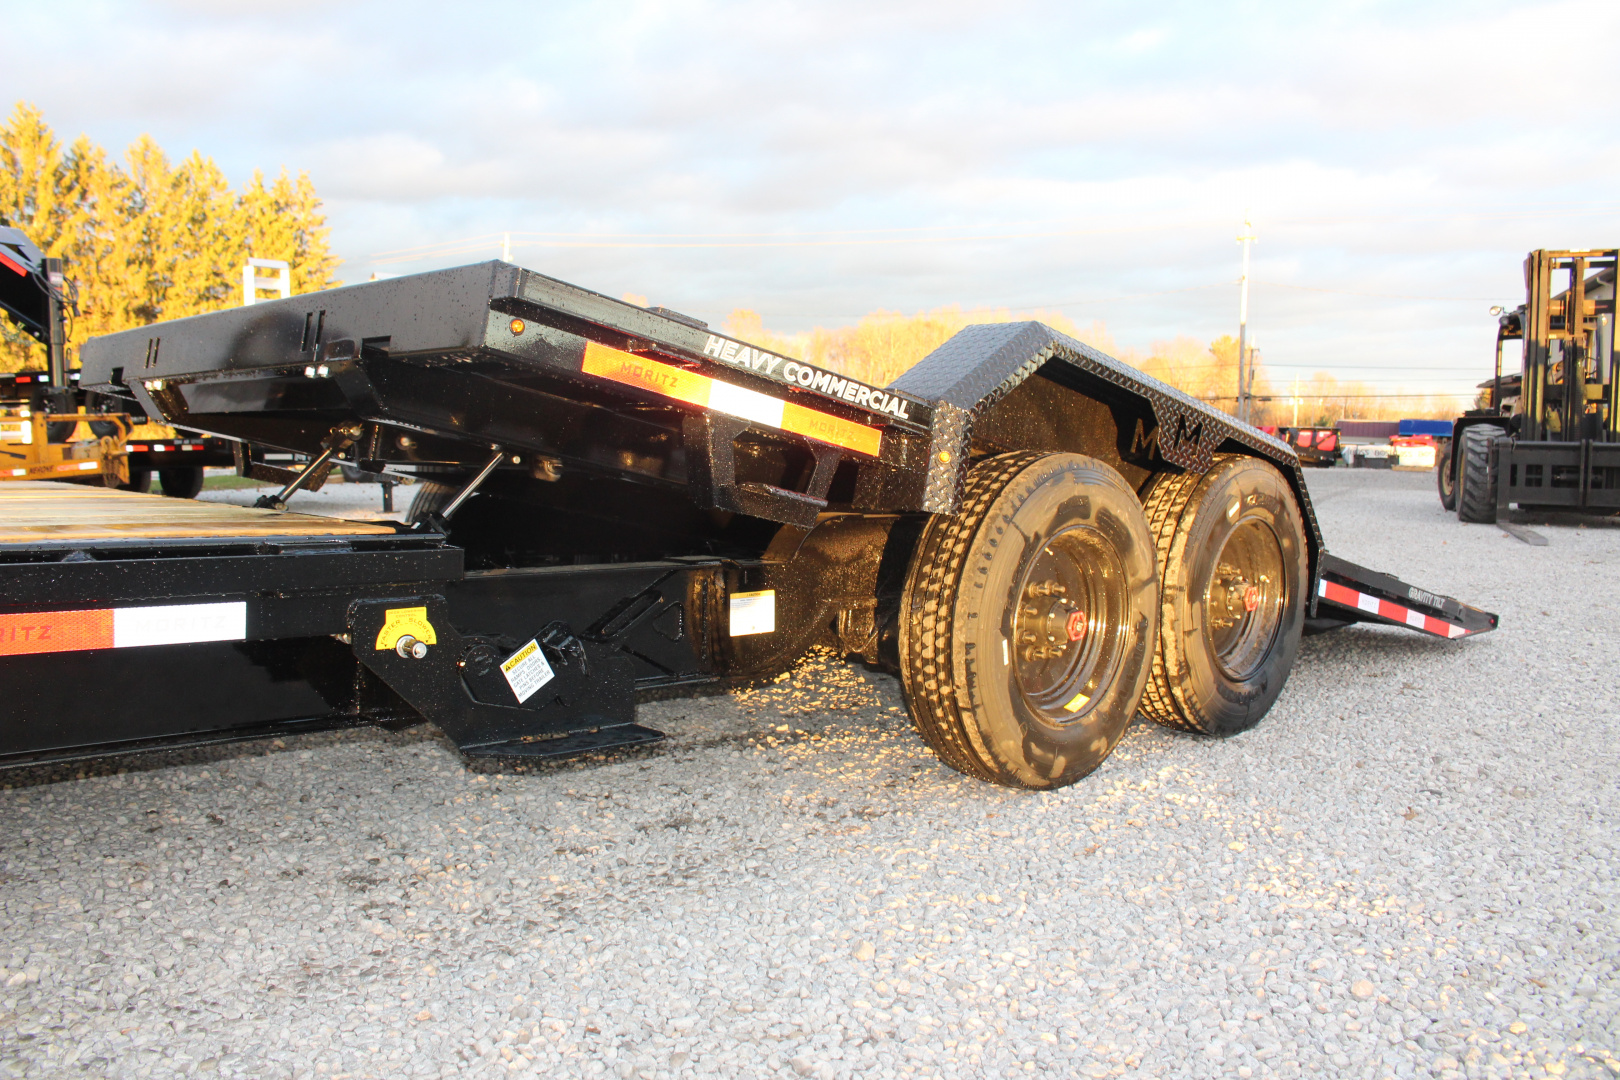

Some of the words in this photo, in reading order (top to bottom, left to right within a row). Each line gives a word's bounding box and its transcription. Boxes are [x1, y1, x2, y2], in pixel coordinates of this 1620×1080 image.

[620, 361, 679, 388] MORITZ
[703, 334, 782, 375] HEAVY
[783, 361, 909, 420] COMMERCIAL
[808, 418, 856, 441] MORITZ
[1408, 586, 1434, 605] GRAVITY
[1432, 595, 1445, 609] TILT
[135, 615, 227, 634] MORITZ
[509, 643, 537, 668] CAUTION
[512, 659, 528, 675] SECURE
[527, 654, 536, 662] ALL
[513, 678, 525, 689] GATE
[524, 664, 542, 680] LATCHES
[518, 684, 535, 698] MOVING
[534, 669, 551, 685] TRAILER
[529, 668, 545, 681] BEFORE
